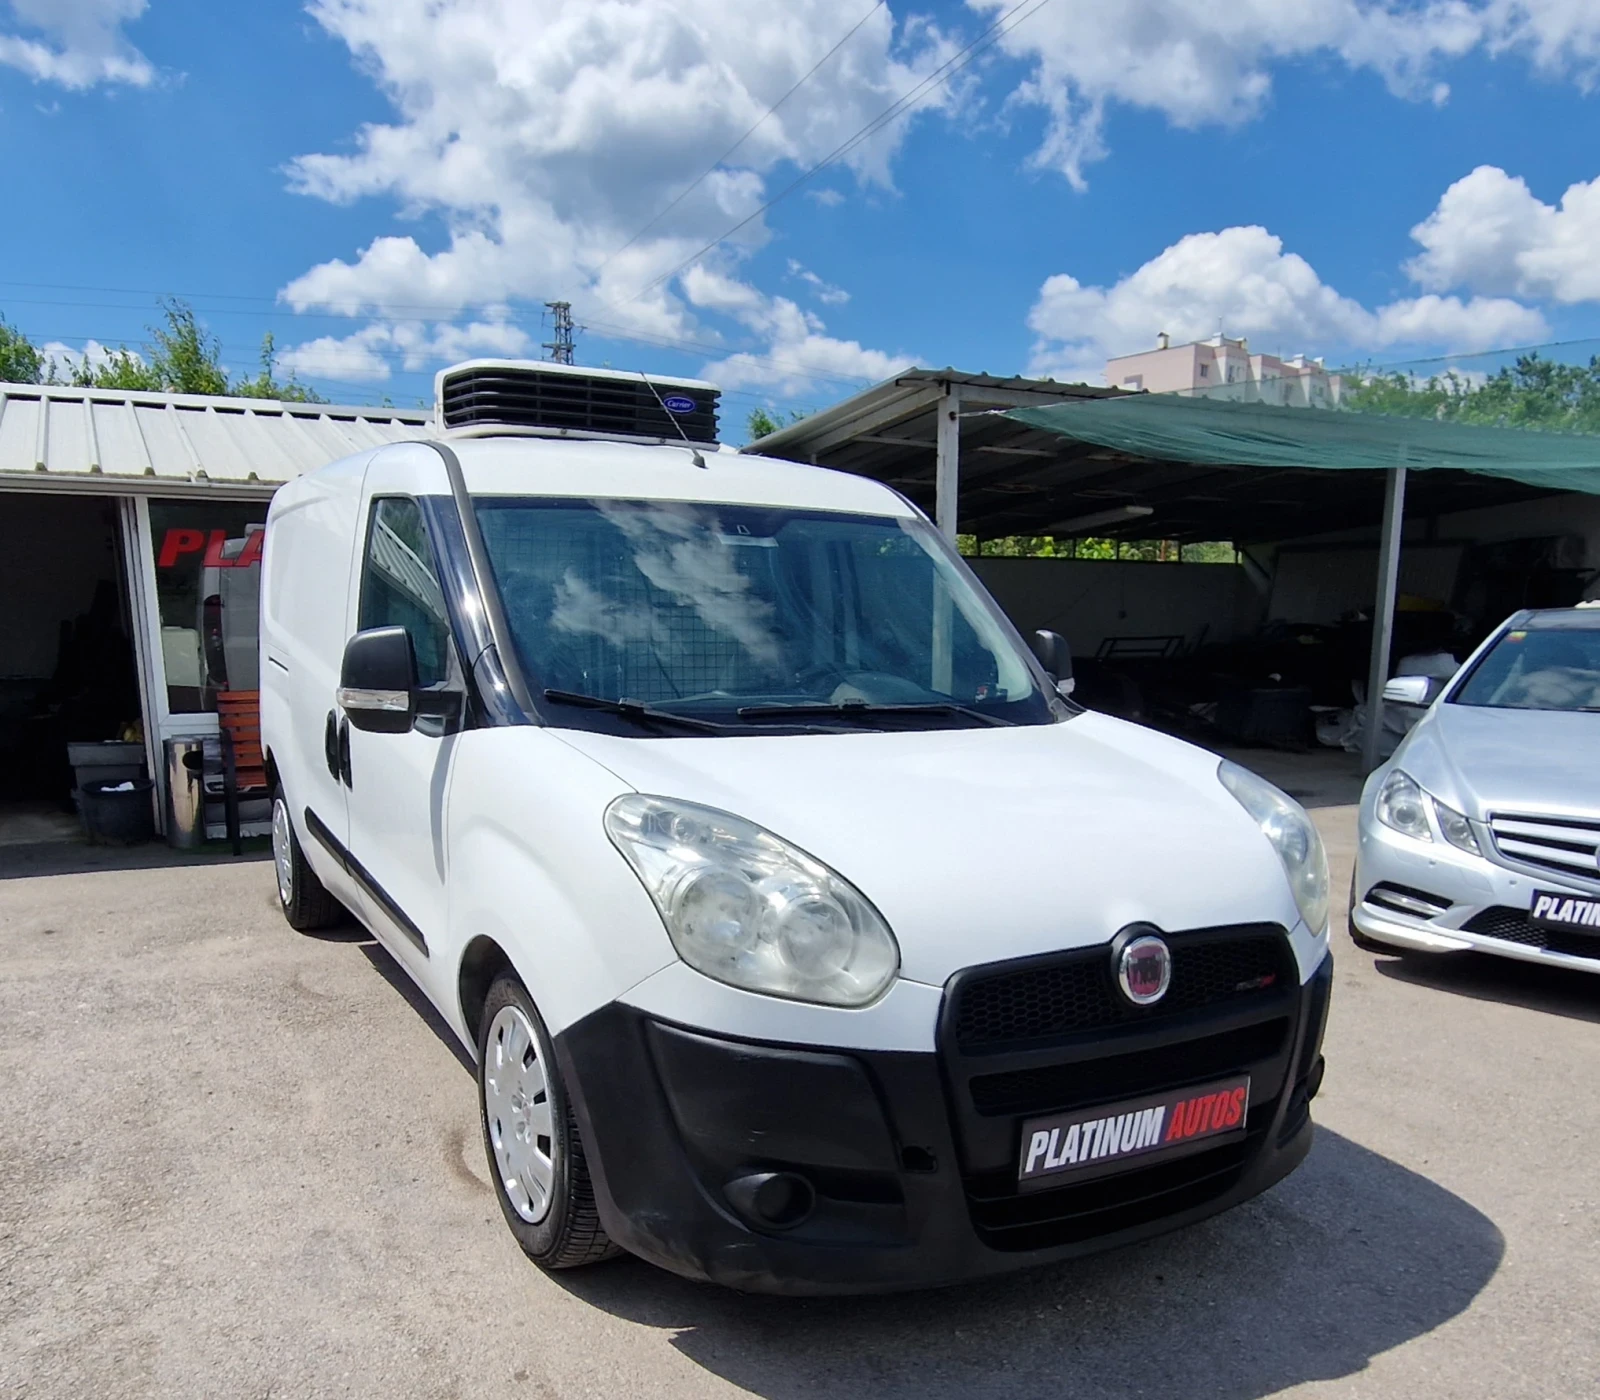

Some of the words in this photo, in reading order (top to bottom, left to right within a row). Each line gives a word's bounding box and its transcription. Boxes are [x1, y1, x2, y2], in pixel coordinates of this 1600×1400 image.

[667, 400, 692, 409] Carrier
[1025, 1105, 1166, 1173] PLATINUM
[1165, 1087, 1245, 1142] AUTOS
